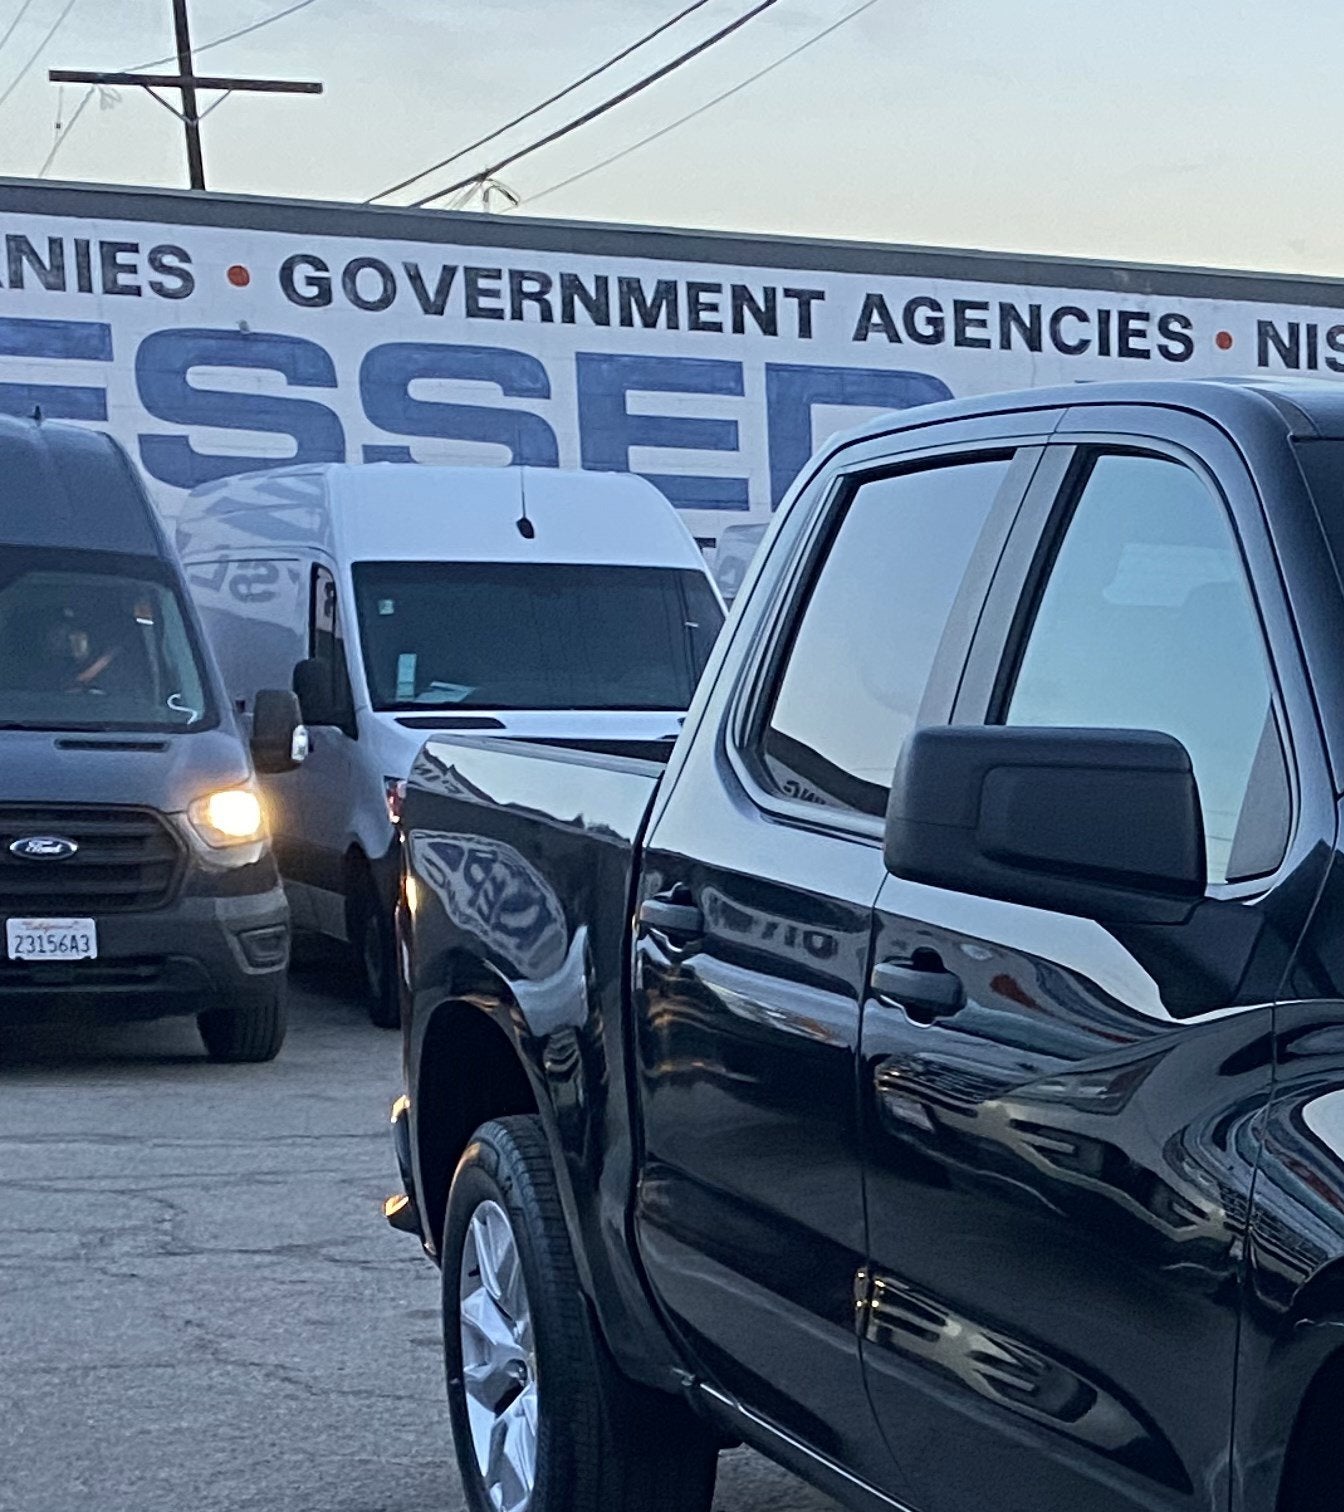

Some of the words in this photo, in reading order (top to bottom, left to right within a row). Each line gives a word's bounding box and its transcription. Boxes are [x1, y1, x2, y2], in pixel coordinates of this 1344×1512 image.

[0, 234, 195, 299] NIES
[279, 253, 824, 340] GOVERNMENT
[854, 293, 1194, 362] AGENCIES
[14, 934, 91, 955] 23156A3
